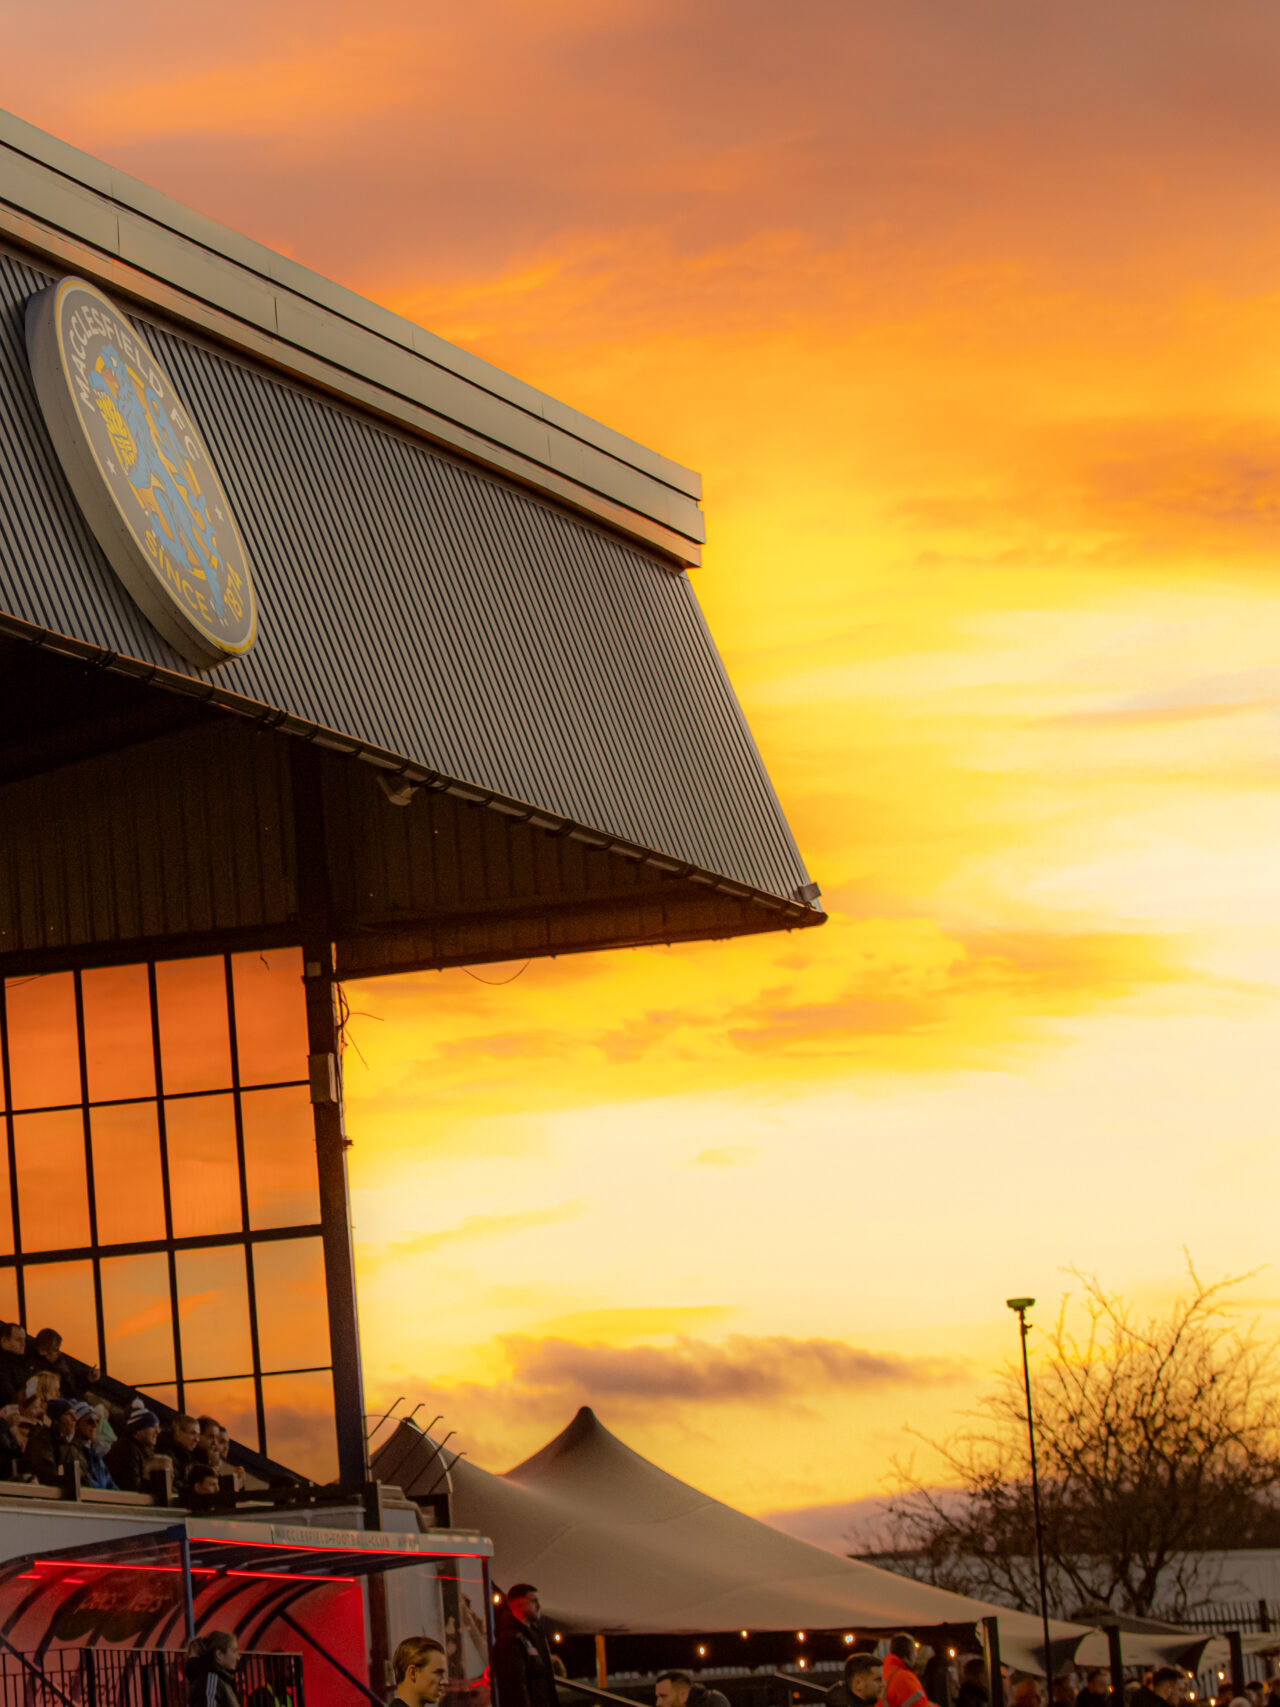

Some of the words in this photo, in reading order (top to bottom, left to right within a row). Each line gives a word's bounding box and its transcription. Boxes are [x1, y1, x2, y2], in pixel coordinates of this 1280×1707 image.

[69, 305, 164, 412] MACCLESFIELD
[170, 408, 201, 461] FC
[145, 530, 215, 623] SINCE
[224, 562, 244, 624] 1874
